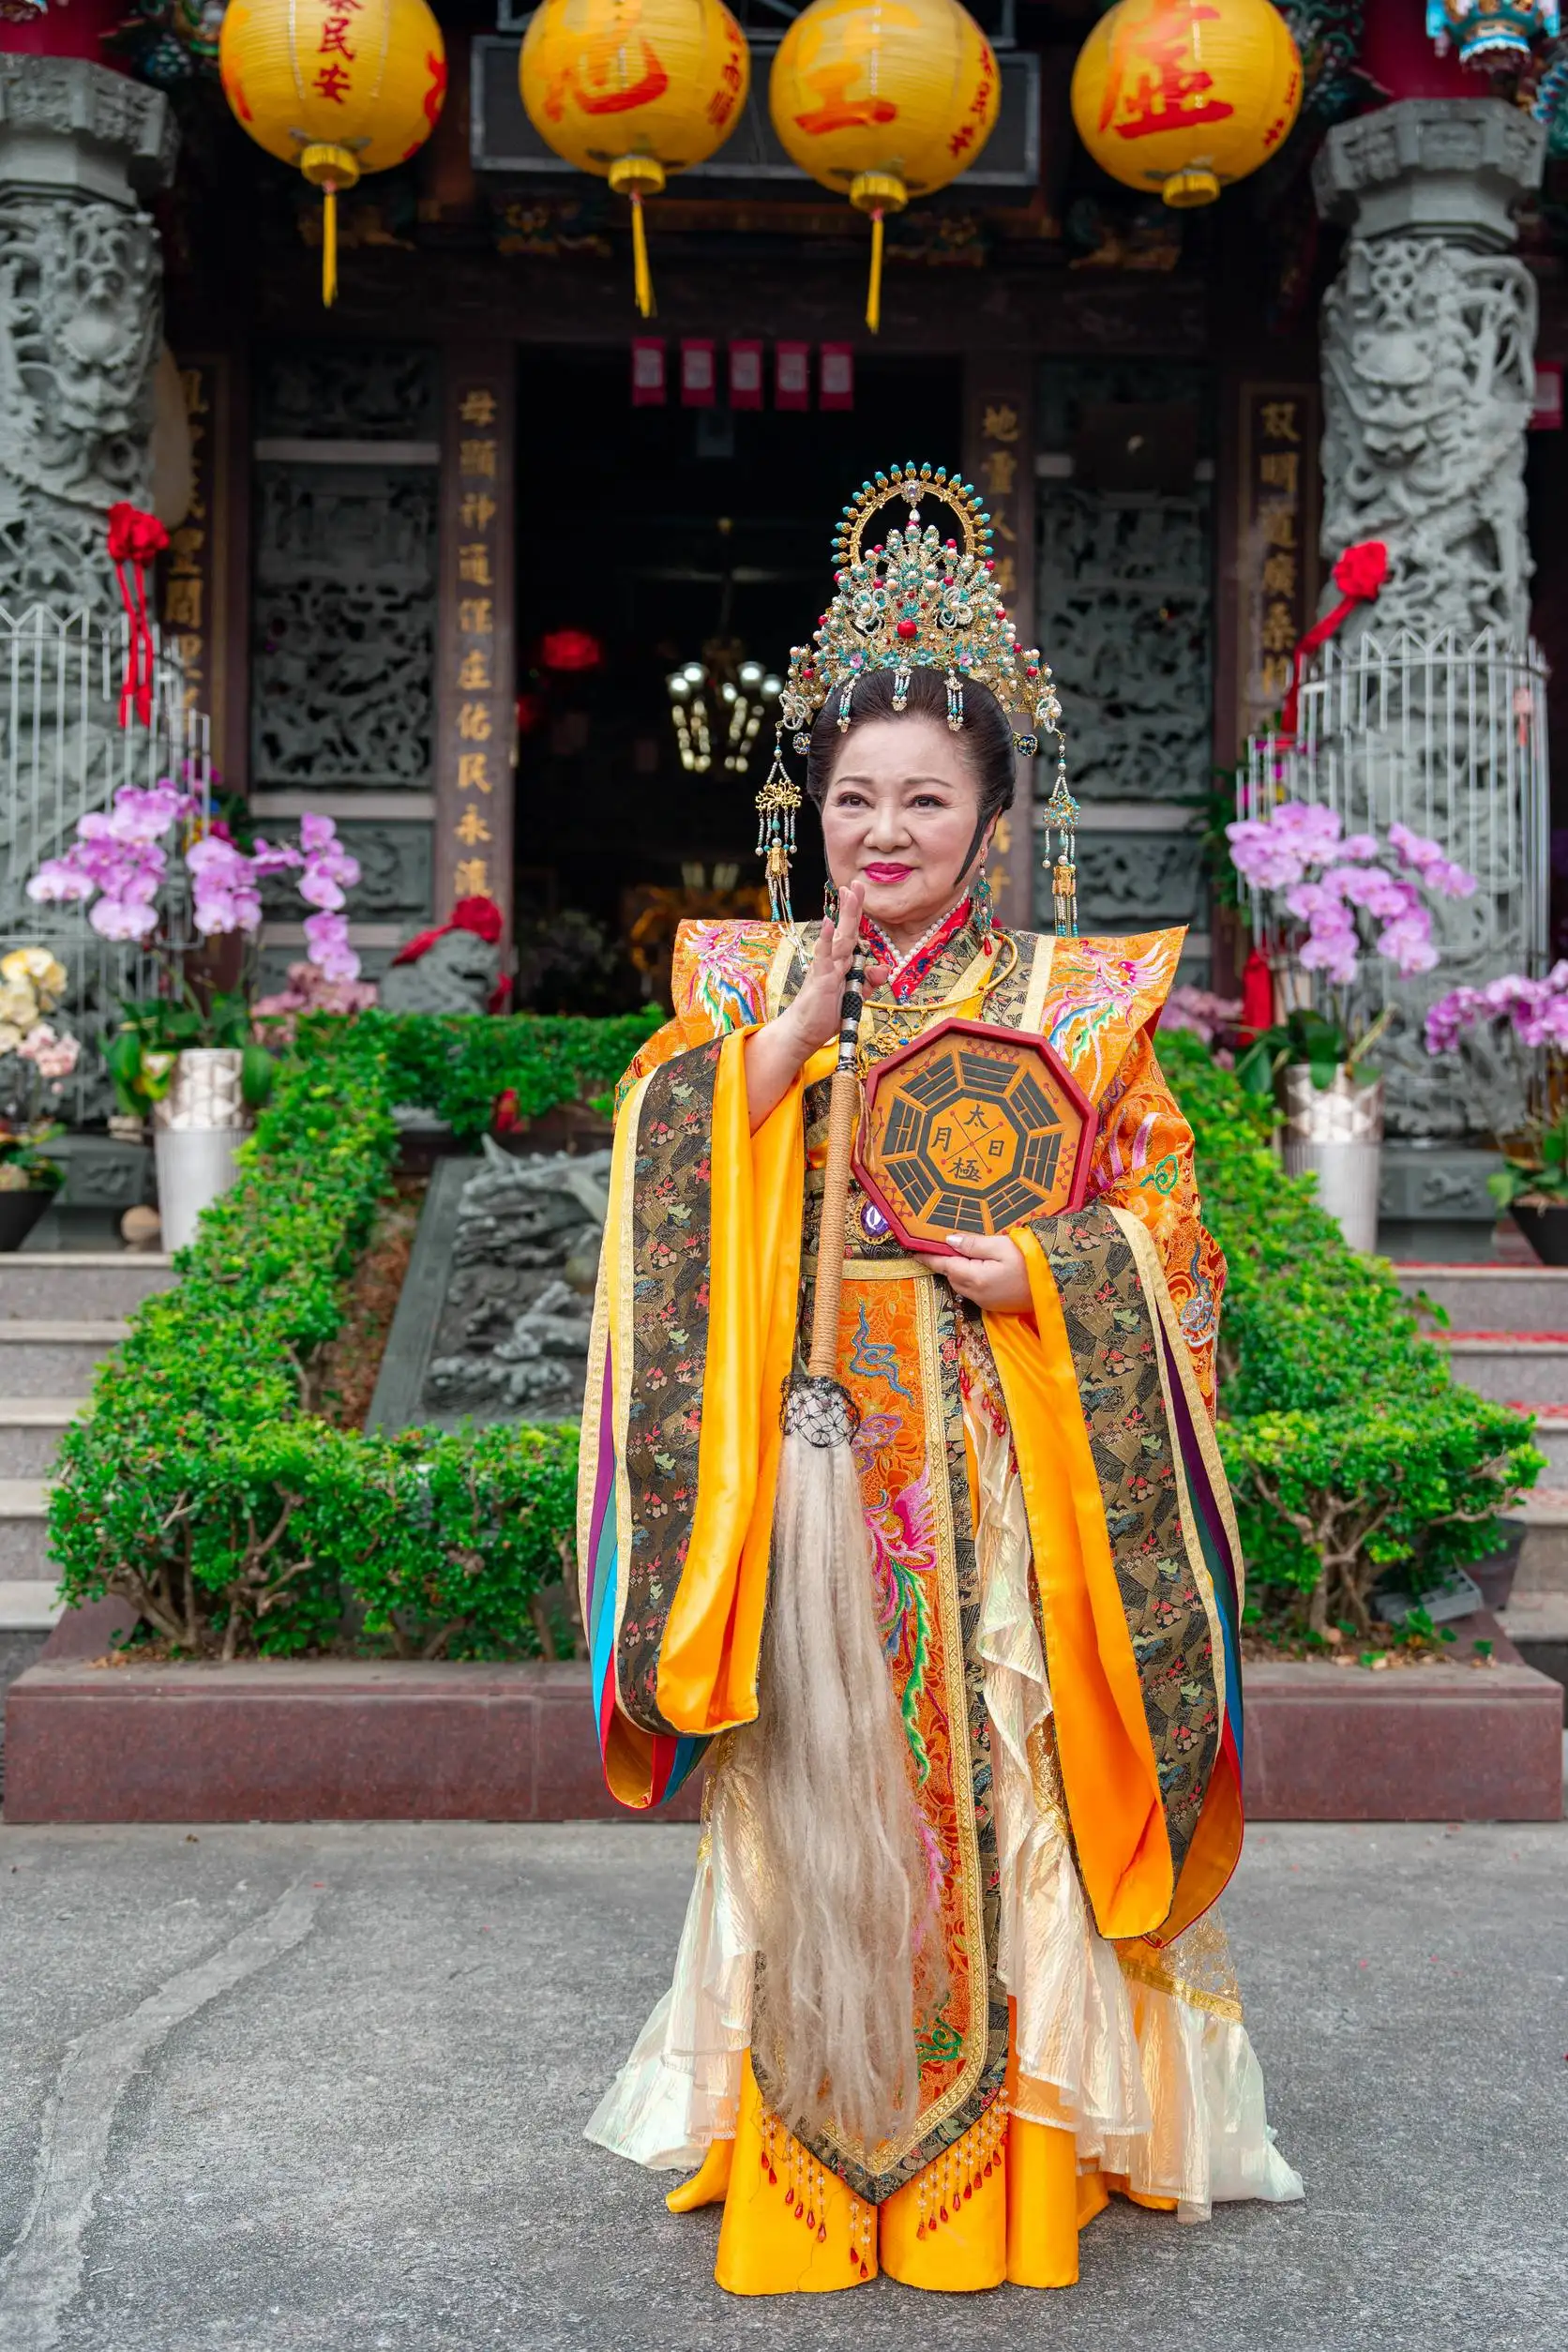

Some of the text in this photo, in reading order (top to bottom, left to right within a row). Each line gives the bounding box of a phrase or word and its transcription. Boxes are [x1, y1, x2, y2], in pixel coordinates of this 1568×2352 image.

[963, 1104, 990, 1130] 太
[931, 1126, 952, 1153] 月
[988, 1139, 1005, 1157] 日
[947, 1157, 982, 1183] 極
